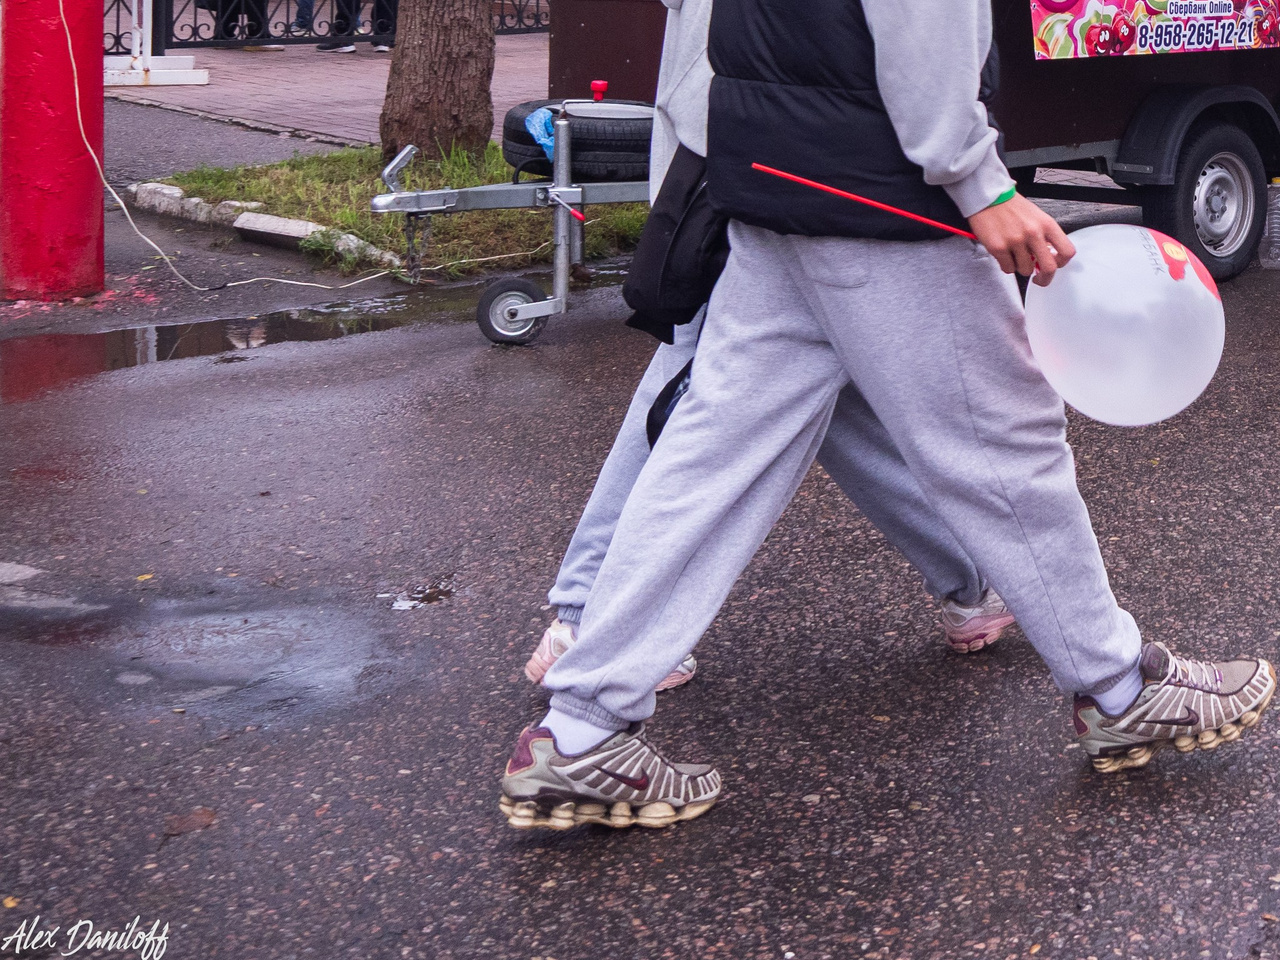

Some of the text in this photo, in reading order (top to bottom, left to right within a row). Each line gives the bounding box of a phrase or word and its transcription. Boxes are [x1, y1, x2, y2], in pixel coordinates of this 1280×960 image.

[1169, 1, 1232, 15] Сбербанк Online
[1139, 21, 1253, 48] 8-958-265-12-21
